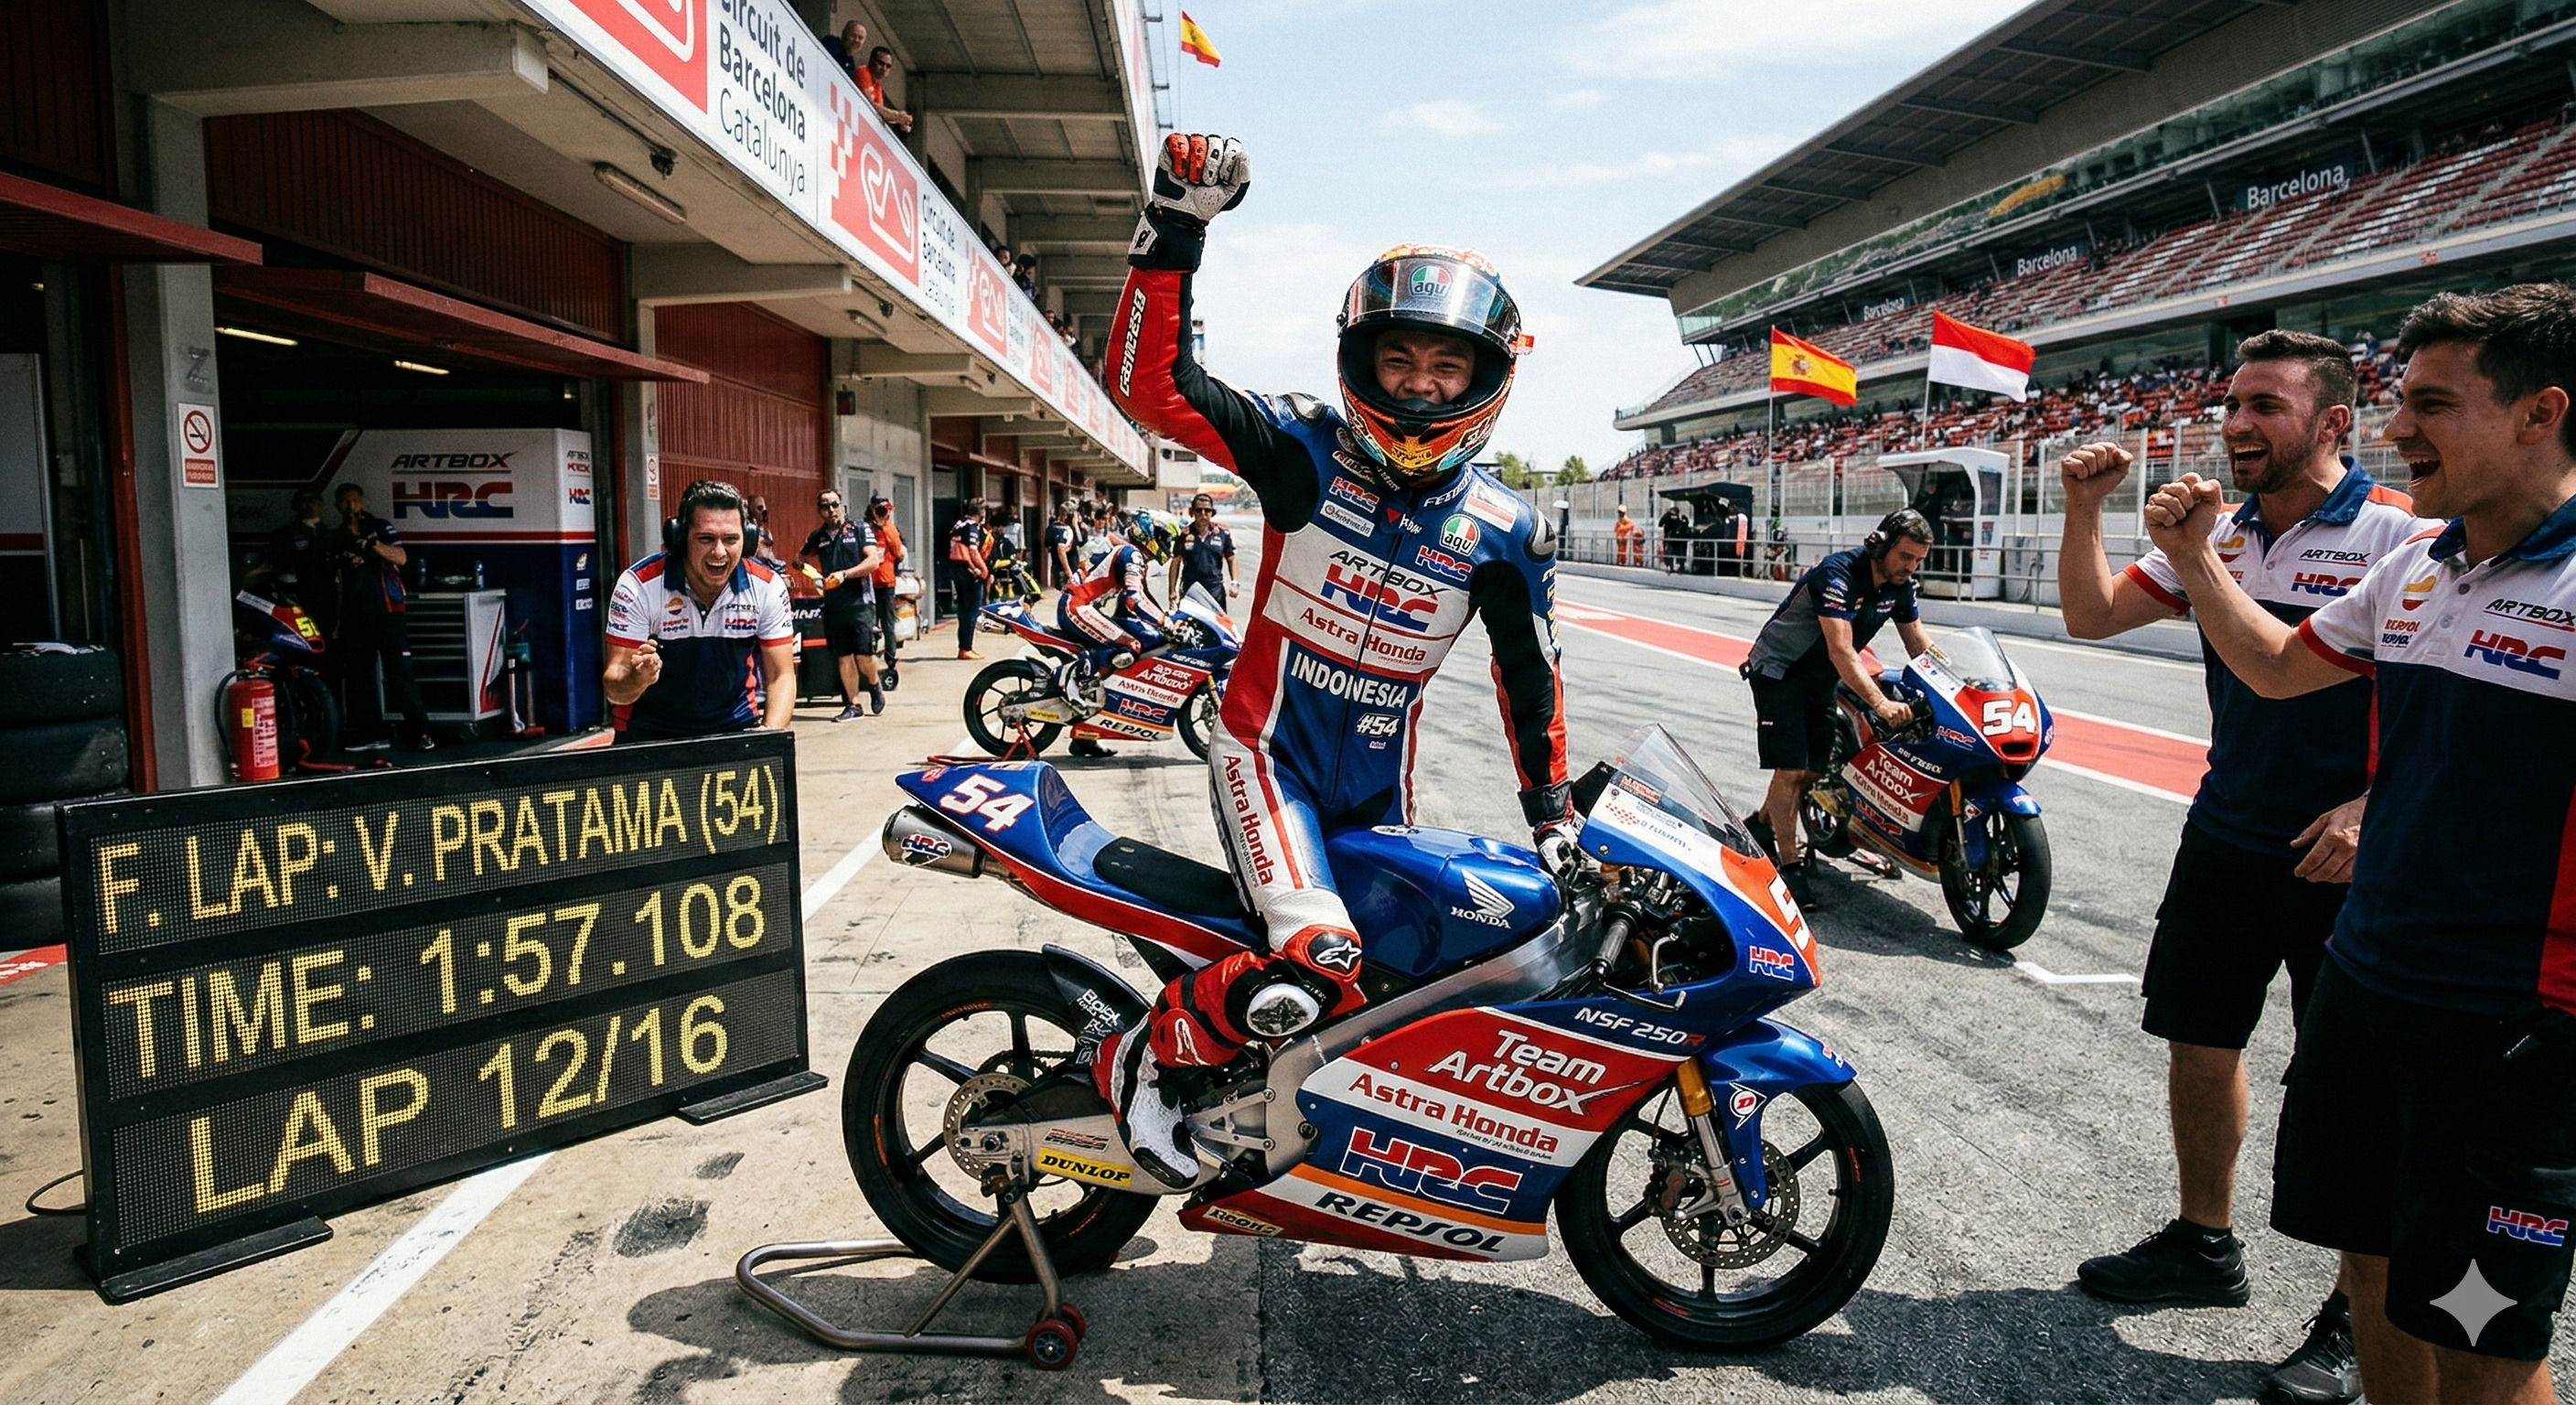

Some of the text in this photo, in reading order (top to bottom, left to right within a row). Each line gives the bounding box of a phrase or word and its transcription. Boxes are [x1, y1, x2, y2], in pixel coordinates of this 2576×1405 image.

[719, 20, 806, 144] Barcelona
[786, 37, 805, 90] de
[720, 88, 806, 197] Catalunya
[2247, 165, 2345, 209] Barcelona
[2017, 245, 2077, 276] Barcelona
[391, 451, 519, 469] ARTBOX
[392, 481, 514, 520] HRC
[1329, 550, 1452, 600] ARTBOX
[1415, 545, 1472, 582] HRC
[2299, 549, 2371, 563] ARTBOX
[1320, 563, 1439, 633] HRC
[2485, 598, 2576, 627] ARTBOX
[1299, 606, 1427, 662] Astra Honda
[2463, 628, 2567, 681] HRC
[1290, 652, 1409, 708] INDONESIA
[1357, 714, 1401, 737] #54
[1982, 699, 2036, 736] 54
[1864, 759, 1923, 805] Artbox
[1877, 750, 1914, 787] Team
[939, 772, 1035, 834] 54
[1222, 755, 1250, 813] Astra
[1240, 811, 1275, 886] Honda
[98, 765, 780, 936] F. LAP: V. PRATAMA (54)
[1450, 906, 1512, 930] HONDA
[108, 874, 767, 1080] TIME: 1:57.108
[1748, 945, 1794, 981] HRC
[1573, 1007, 1706, 1047] NSF 250R
[1493, 1028, 1607, 1086] Team
[189, 993, 729, 1215] LAP 12/16
[1425, 1049, 1597, 1117] Artbox
[1348, 1072, 1446, 1121] Astra
[1450, 1103, 1560, 1153] Honda
[1041, 1154, 1131, 1182] DUNLOP
[1338, 1125, 1523, 1215] HRC
[1314, 1191, 1507, 1253] REPSOL
[2485, 1205, 2569, 1247] HRC
